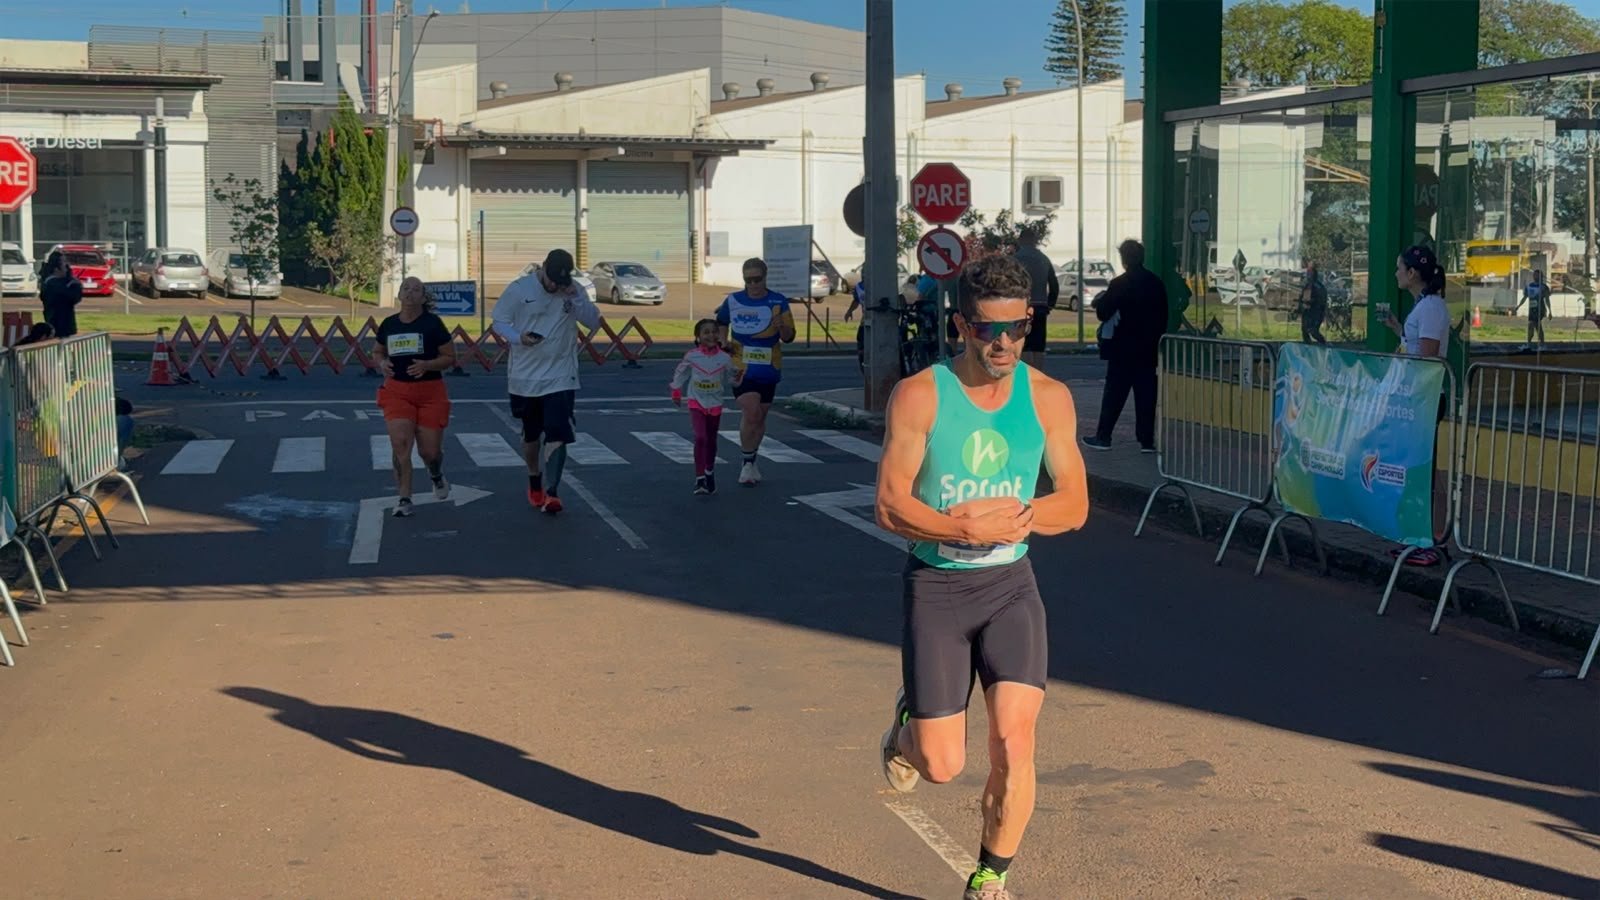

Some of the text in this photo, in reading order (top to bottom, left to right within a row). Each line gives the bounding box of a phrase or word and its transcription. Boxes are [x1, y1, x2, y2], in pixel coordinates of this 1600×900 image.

[44, 134, 103, 149] Diesel
[0, 161, 29, 186] RE
[914, 183, 968, 206] PARE
[444, 292, 461, 300] VIA
[1378, 467, 1404, 479] ESPORTES
[940, 474, 1022, 503] Sprint
